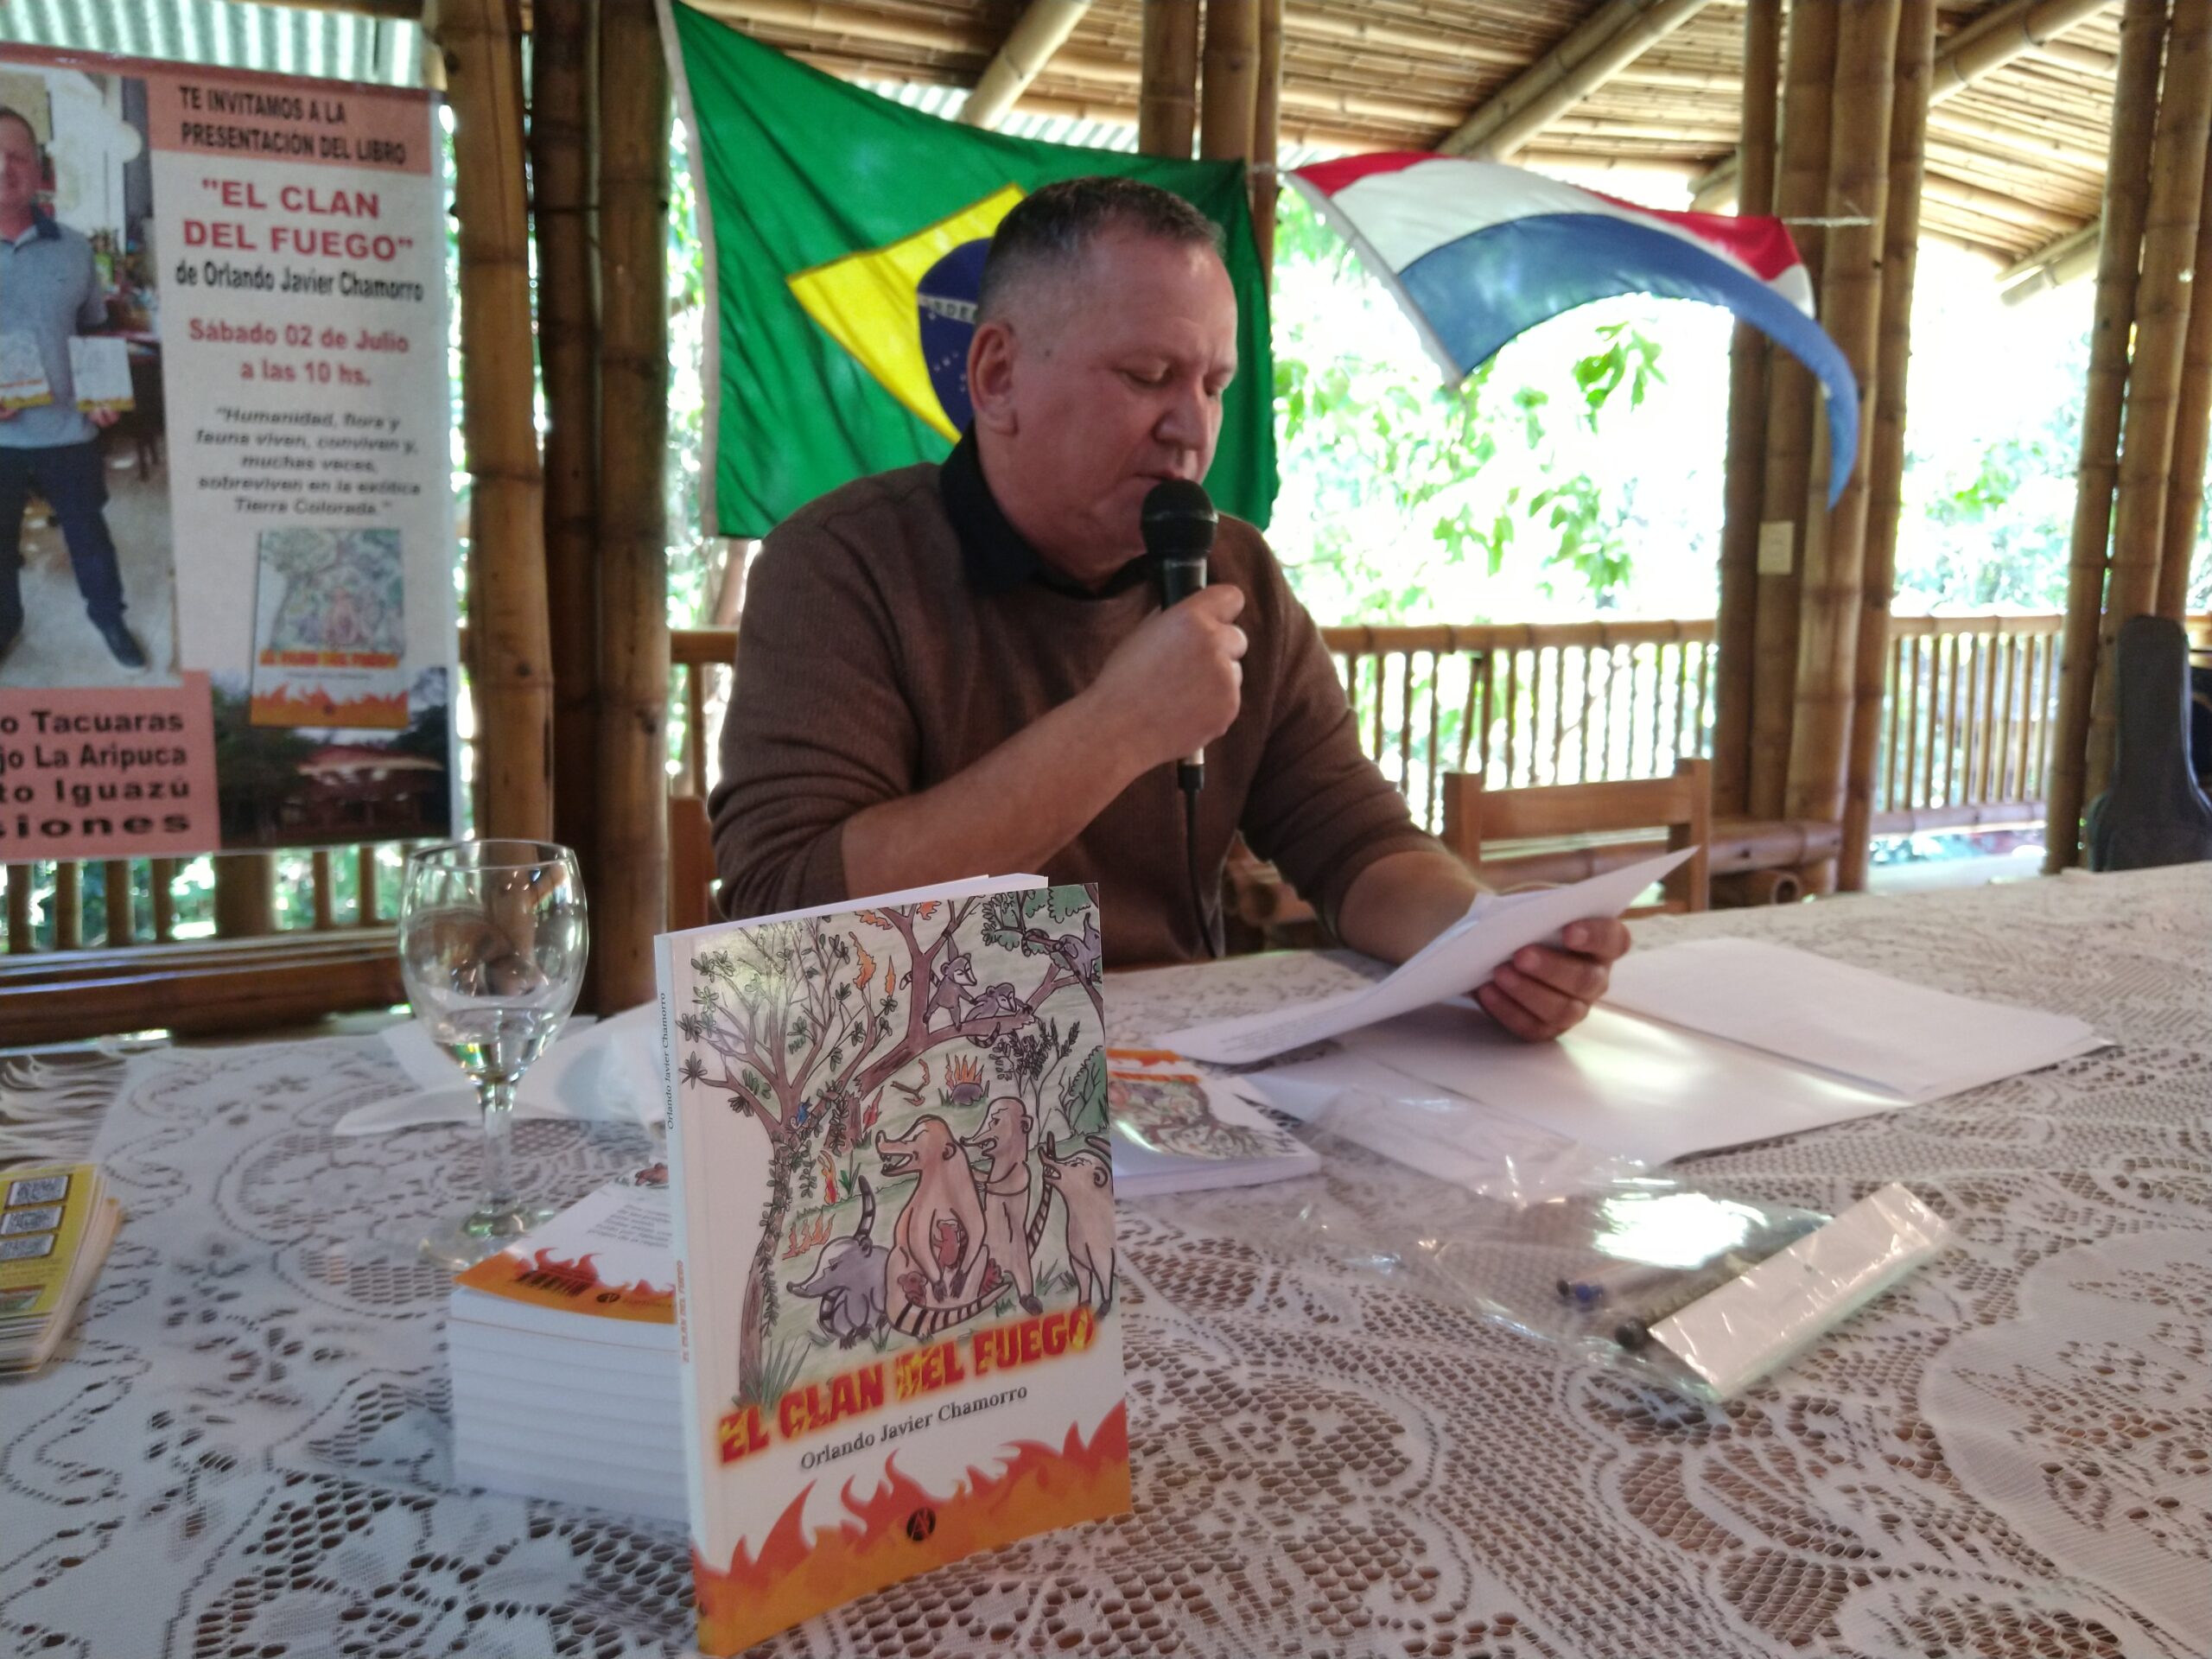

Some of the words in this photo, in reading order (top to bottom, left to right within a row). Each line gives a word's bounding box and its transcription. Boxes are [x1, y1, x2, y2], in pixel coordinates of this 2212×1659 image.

[179, 86, 201, 110] TE
[207, 89, 303, 119] INVITAMOS
[308, 100, 321, 123] A
[325, 101, 346, 124] LA
[319, 136, 350, 159] DEL
[356, 139, 407, 165] LIBRO
[279, 186, 378, 219] CLAN
[184, 219, 257, 251] DEL
[270, 226, 413, 263] FUEGO"
[175, 259, 198, 286] de
[203, 262, 275, 291] Orlando
[280, 267, 334, 296] Javier
[338, 270, 424, 302] Chamorro
[284, 323, 313, 347] 02
[320, 327, 347, 349] de
[354, 329, 410, 353] Julio
[239, 361, 254, 380] a
[262, 359, 296, 382] las
[304, 361, 331, 384] 10
[338, 363, 372, 387] hs.
[195, 429, 251, 445] fauna
[240, 454, 316, 471] muchas
[308, 480, 332, 493] en
[234, 496, 289, 514] Tierra
[31, 710, 184, 734] Tacuaras
[35, 744, 69, 768] La
[80, 743, 188, 771] Aripuca
[56, 779, 189, 808] Iguazú
[719, 1405, 771, 1464] EL
[778, 1364, 886, 1440] CLAN
[895, 1339, 965, 1402] DEL
[973, 1307, 1096, 1376] FUEGO
[800, 1433, 875, 1471] Orlando
[880, 1414, 934, 1443] Javier
[938, 1385, 1028, 1422] Chamorro
